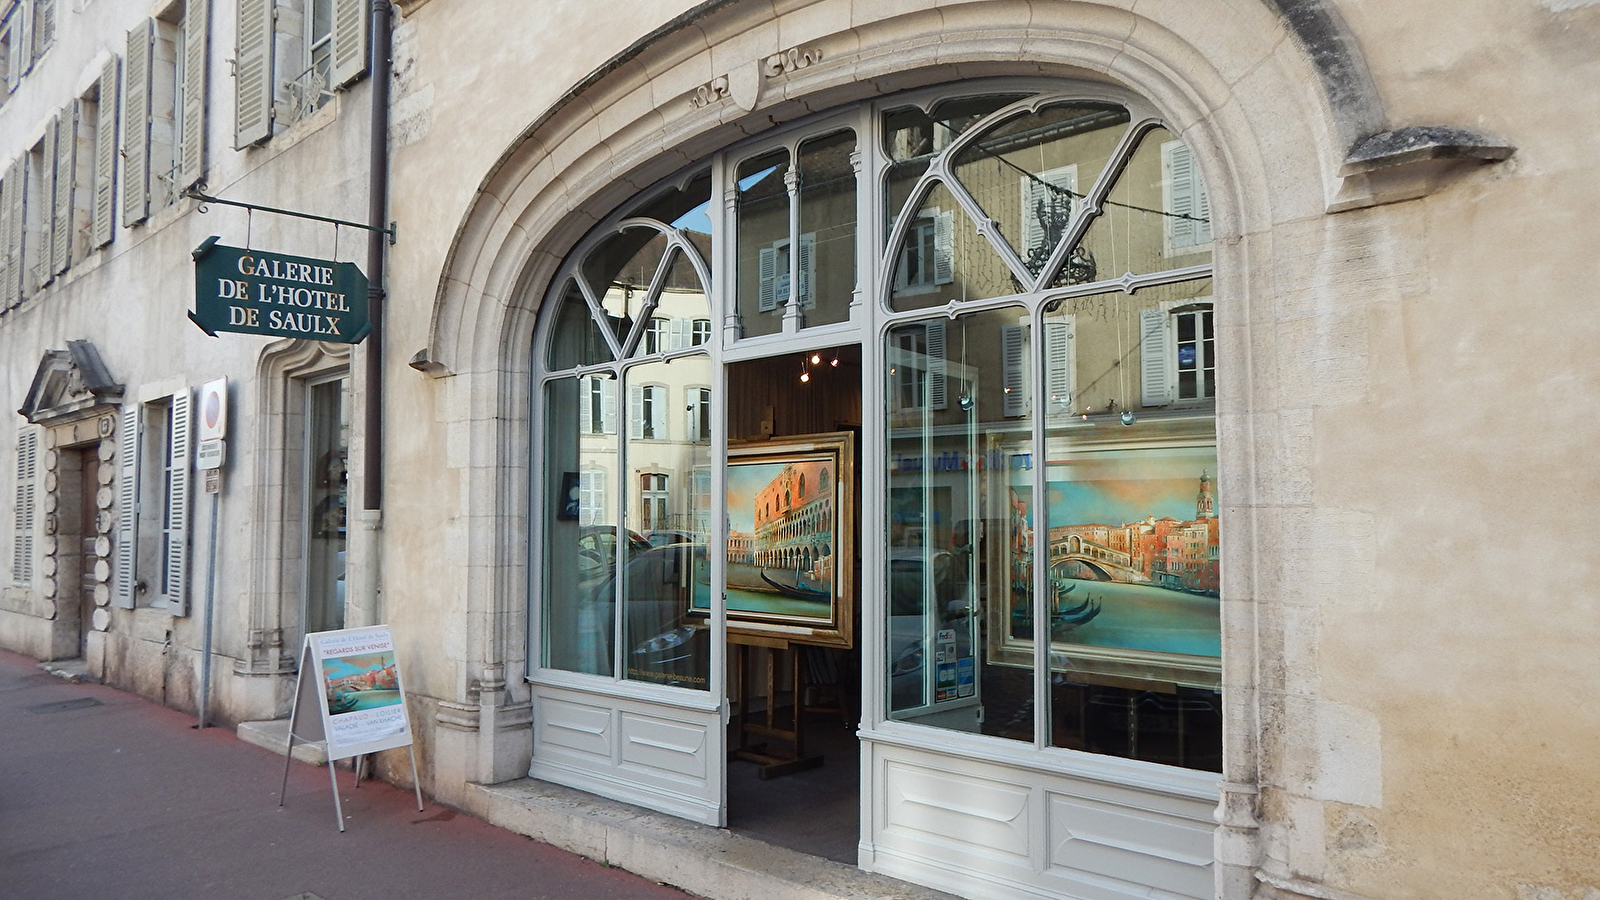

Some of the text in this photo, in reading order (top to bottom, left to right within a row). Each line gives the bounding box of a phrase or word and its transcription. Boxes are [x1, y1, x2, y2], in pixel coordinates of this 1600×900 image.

[237, 255, 334, 286] GALERIE
[218, 278, 350, 313] DE L'HOTEL
[229, 306, 341, 336] DE SAULX
[938, 631, 953, 640] FedEx
[332, 713, 369, 725] CHAPAUD
